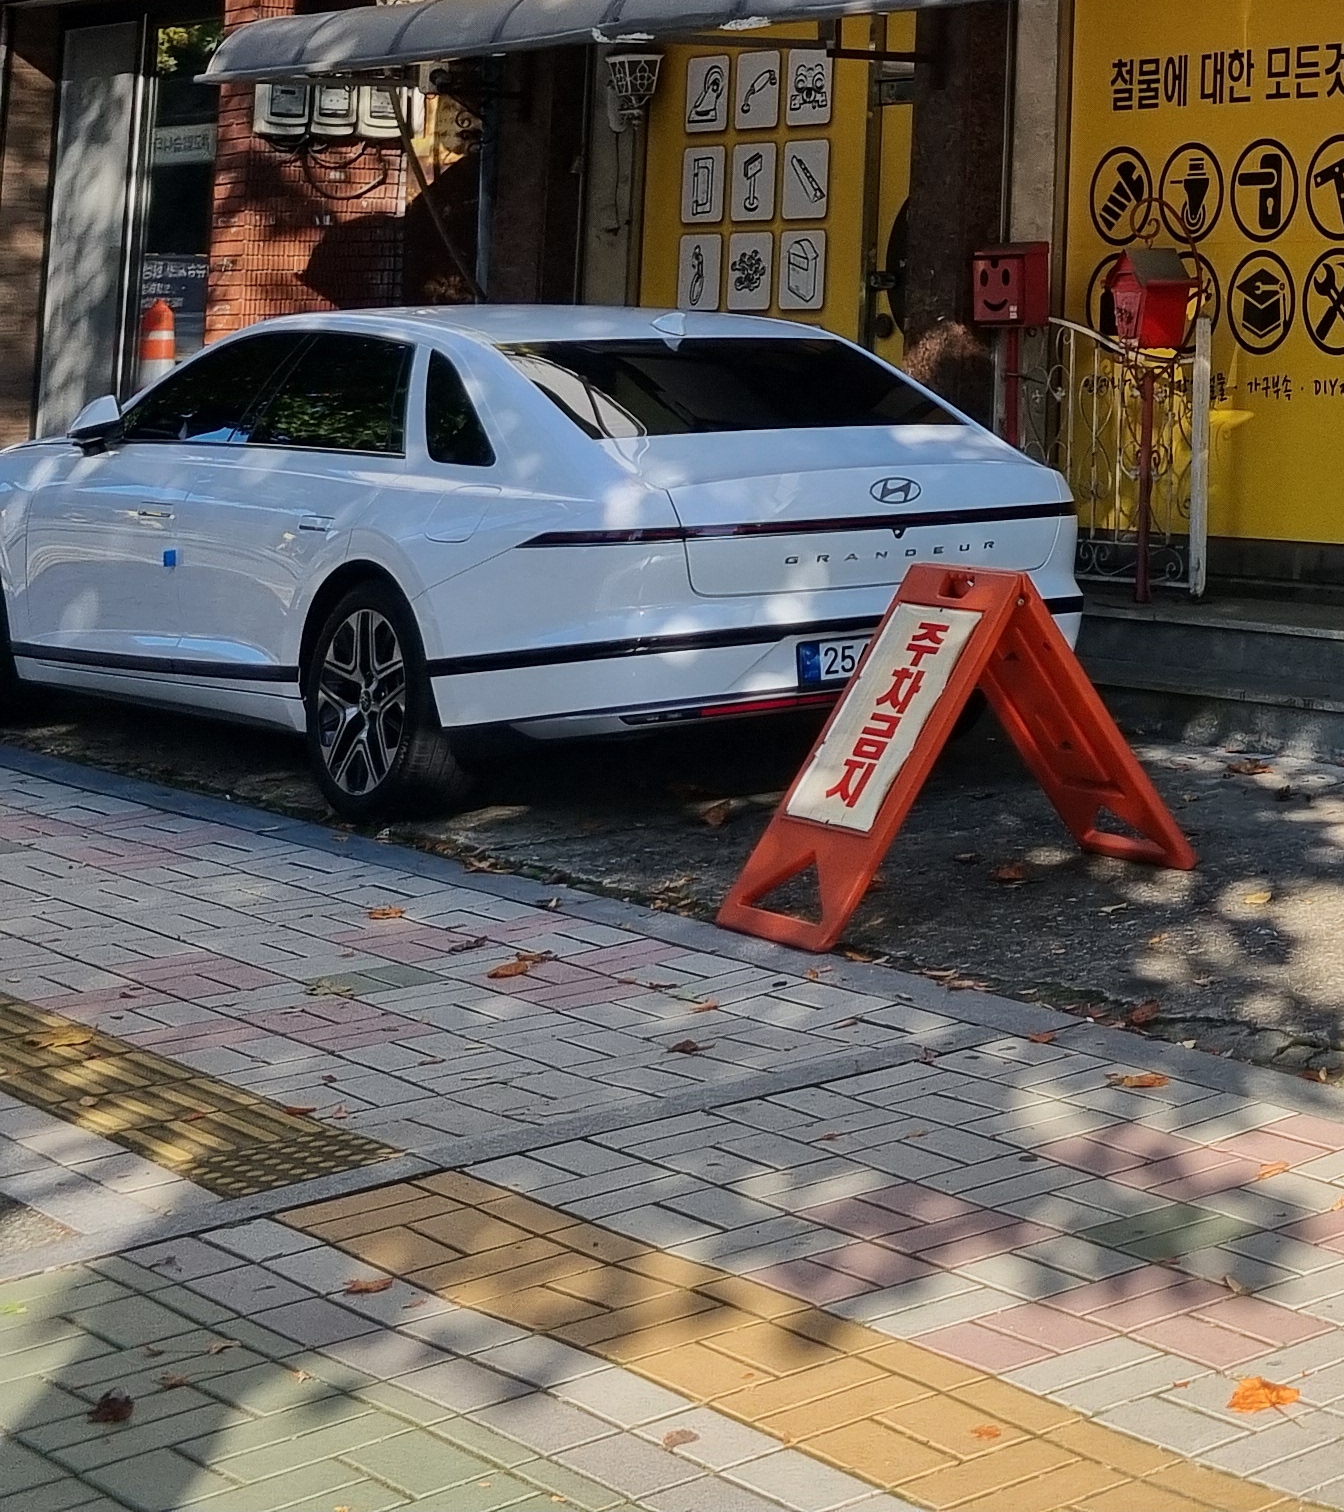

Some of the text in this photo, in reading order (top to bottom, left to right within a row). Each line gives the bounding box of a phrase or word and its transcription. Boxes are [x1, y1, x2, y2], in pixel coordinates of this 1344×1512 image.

[1110, 54, 1189, 112] 철물에
[1200, 49, 1255, 105] 대한
[1247, 374, 1294, 401] 가구부속
[784, 540, 995, 565] GRANDEUR
[823, 642, 869, 675] 25
[826, 621, 950, 808] 주차금지
